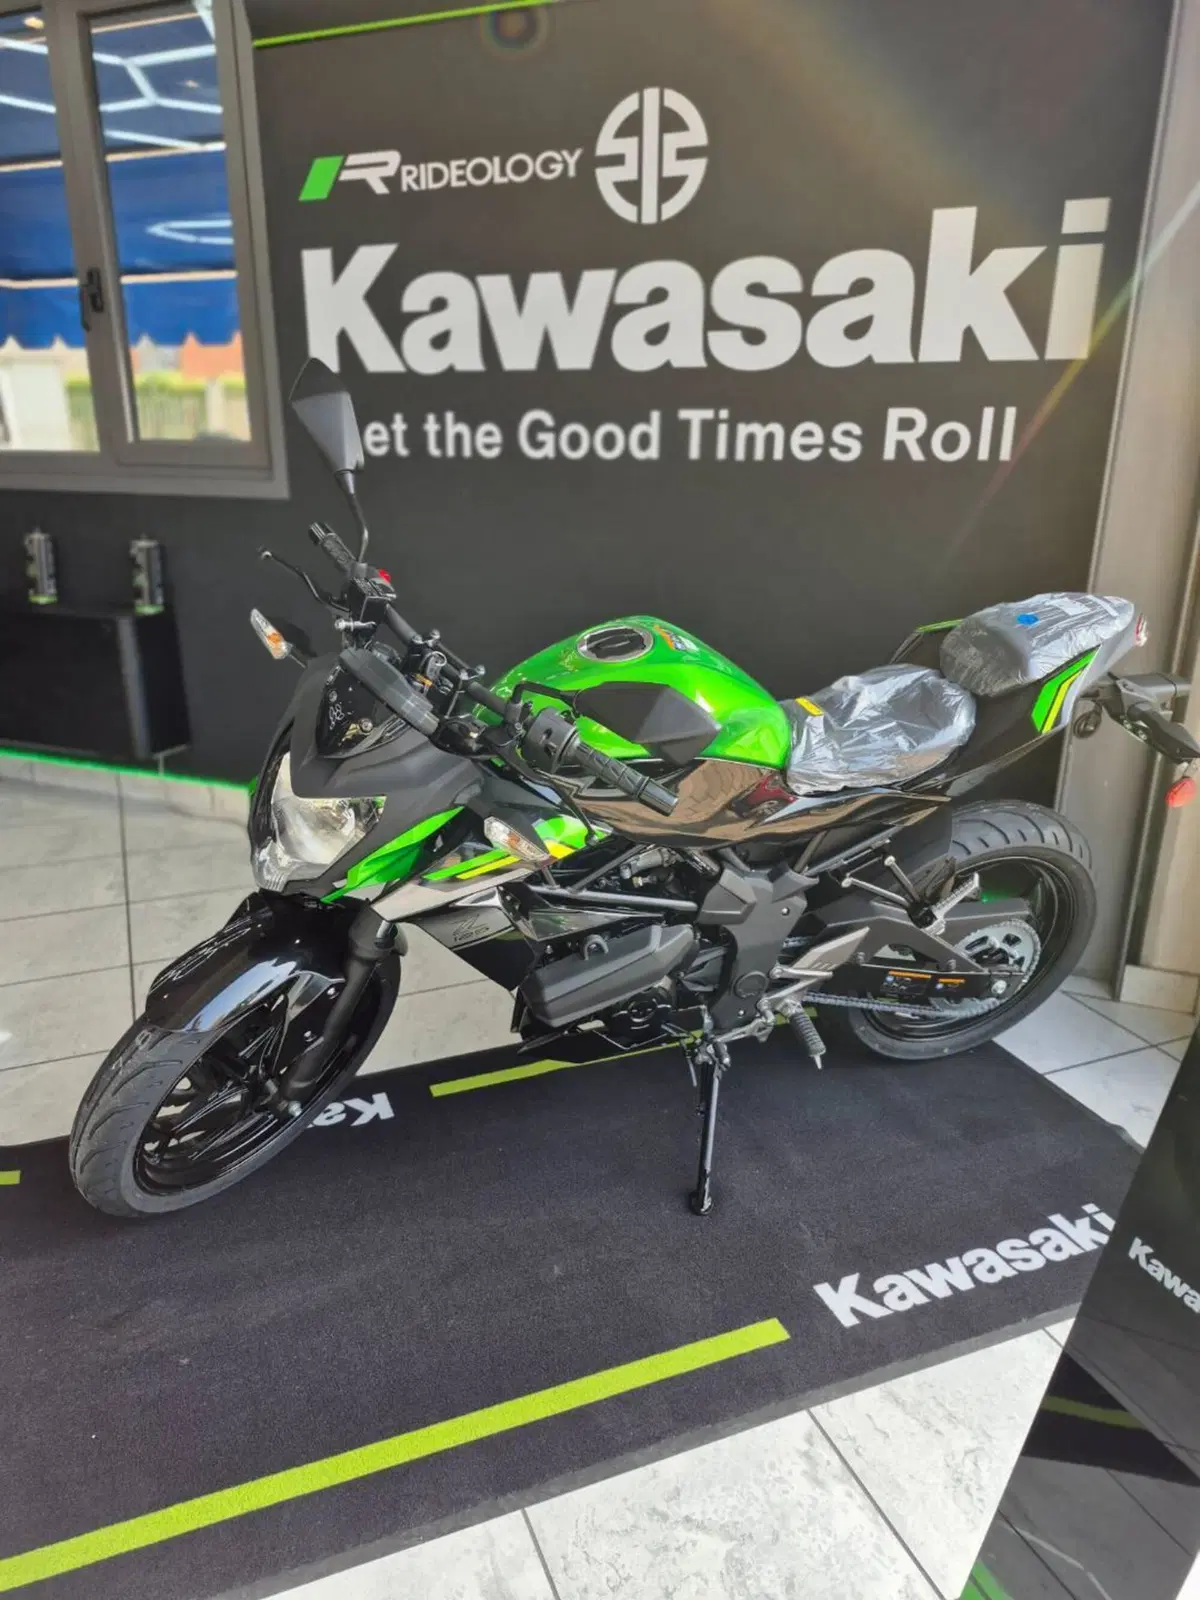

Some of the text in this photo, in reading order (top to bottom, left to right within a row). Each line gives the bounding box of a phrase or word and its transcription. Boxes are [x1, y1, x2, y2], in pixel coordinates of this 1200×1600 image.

[401, 149, 583, 191] RIDEOLOGY
[301, 197, 1111, 372] Kawasaki
[363, 406, 1017, 462] et the Good Times Roll
[813, 1203, 1116, 1327] Kawasaki
